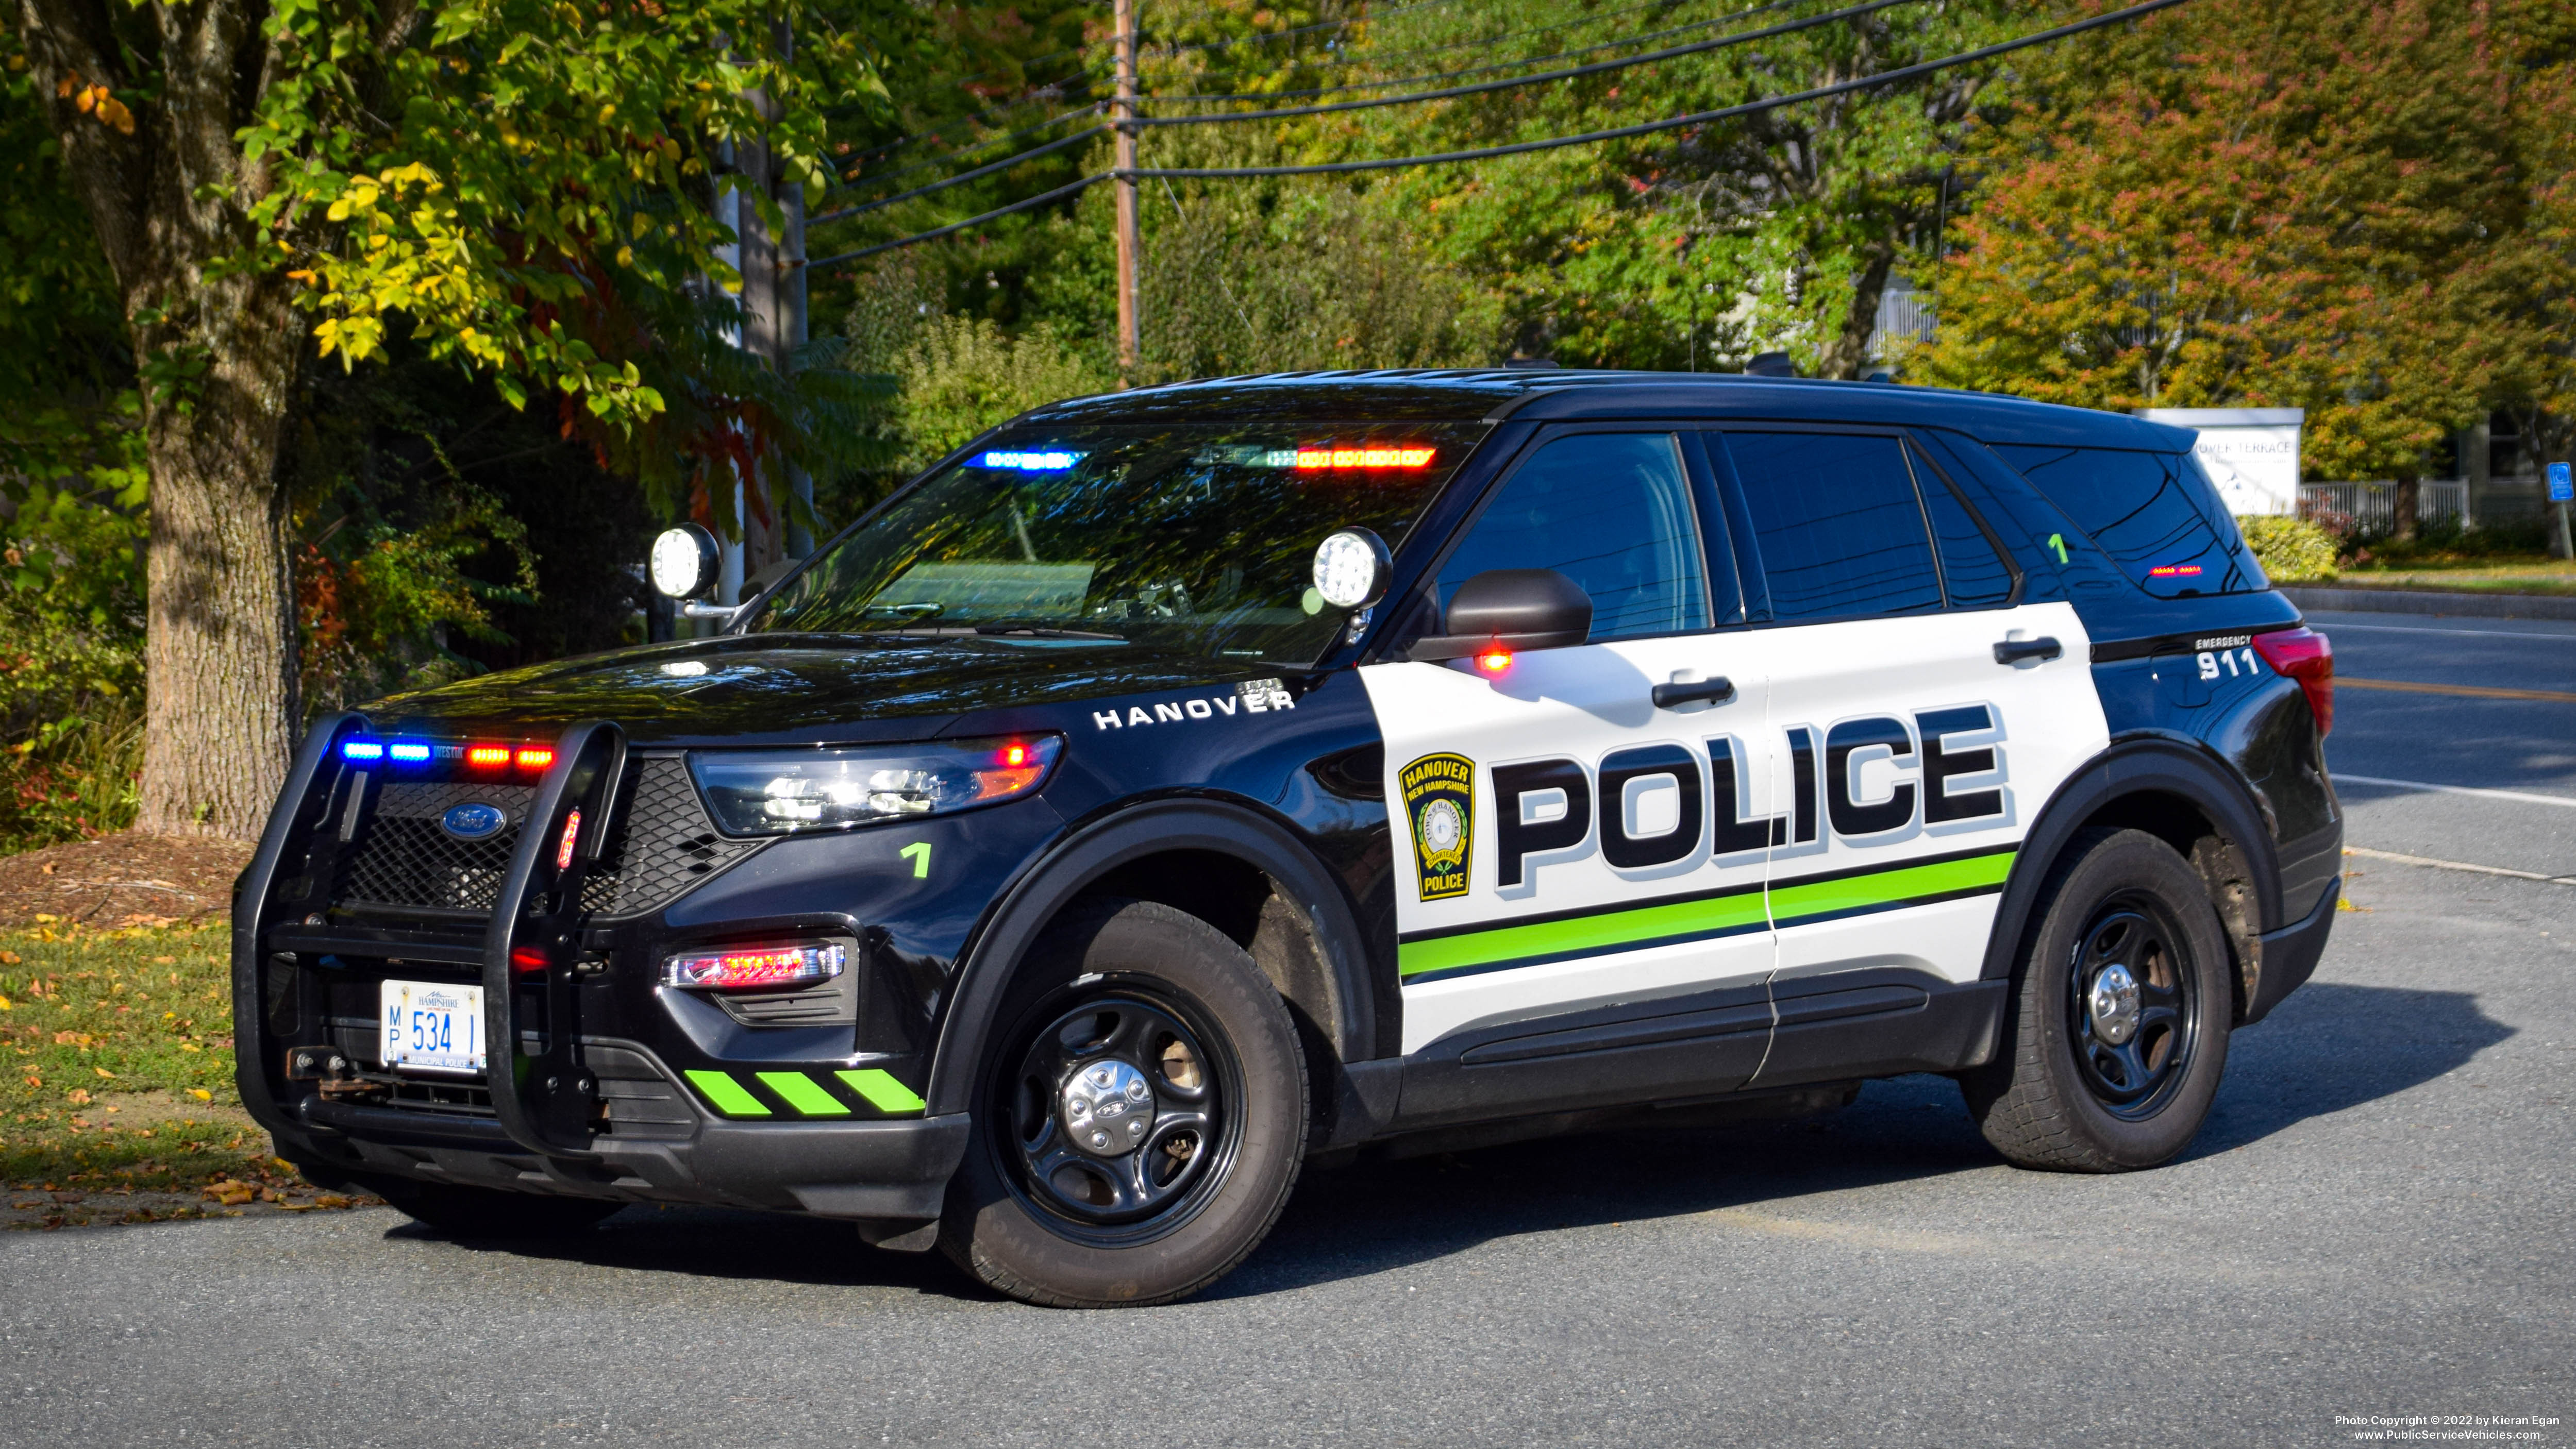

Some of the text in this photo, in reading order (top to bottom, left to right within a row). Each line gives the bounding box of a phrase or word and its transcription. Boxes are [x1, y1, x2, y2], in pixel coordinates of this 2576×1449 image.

[2239, 442, 2290, 453] TERRACE
[2048, 533, 2069, 564] 1
[2197, 635, 2251, 649] EMERGENCY
[2197, 648, 2259, 679] 911
[1092, 690, 1295, 730] HANOVER
[1404, 760, 1469, 789] HANOVER
[1407, 780, 1469, 802] NEW HAMPSHIRE
[1488, 699, 2017, 901] POLICE
[1437, 802, 1460, 838] HANOVER
[900, 841, 932, 879] 1
[1428, 852, 1460, 866] CHARTERED
[1425, 872, 1464, 892] POLICE
[419, 996, 458, 1008] HAMPSHIRE
[413, 1011, 451, 1052] 534
[409, 1056, 443, 1066] MUNICIPAL
